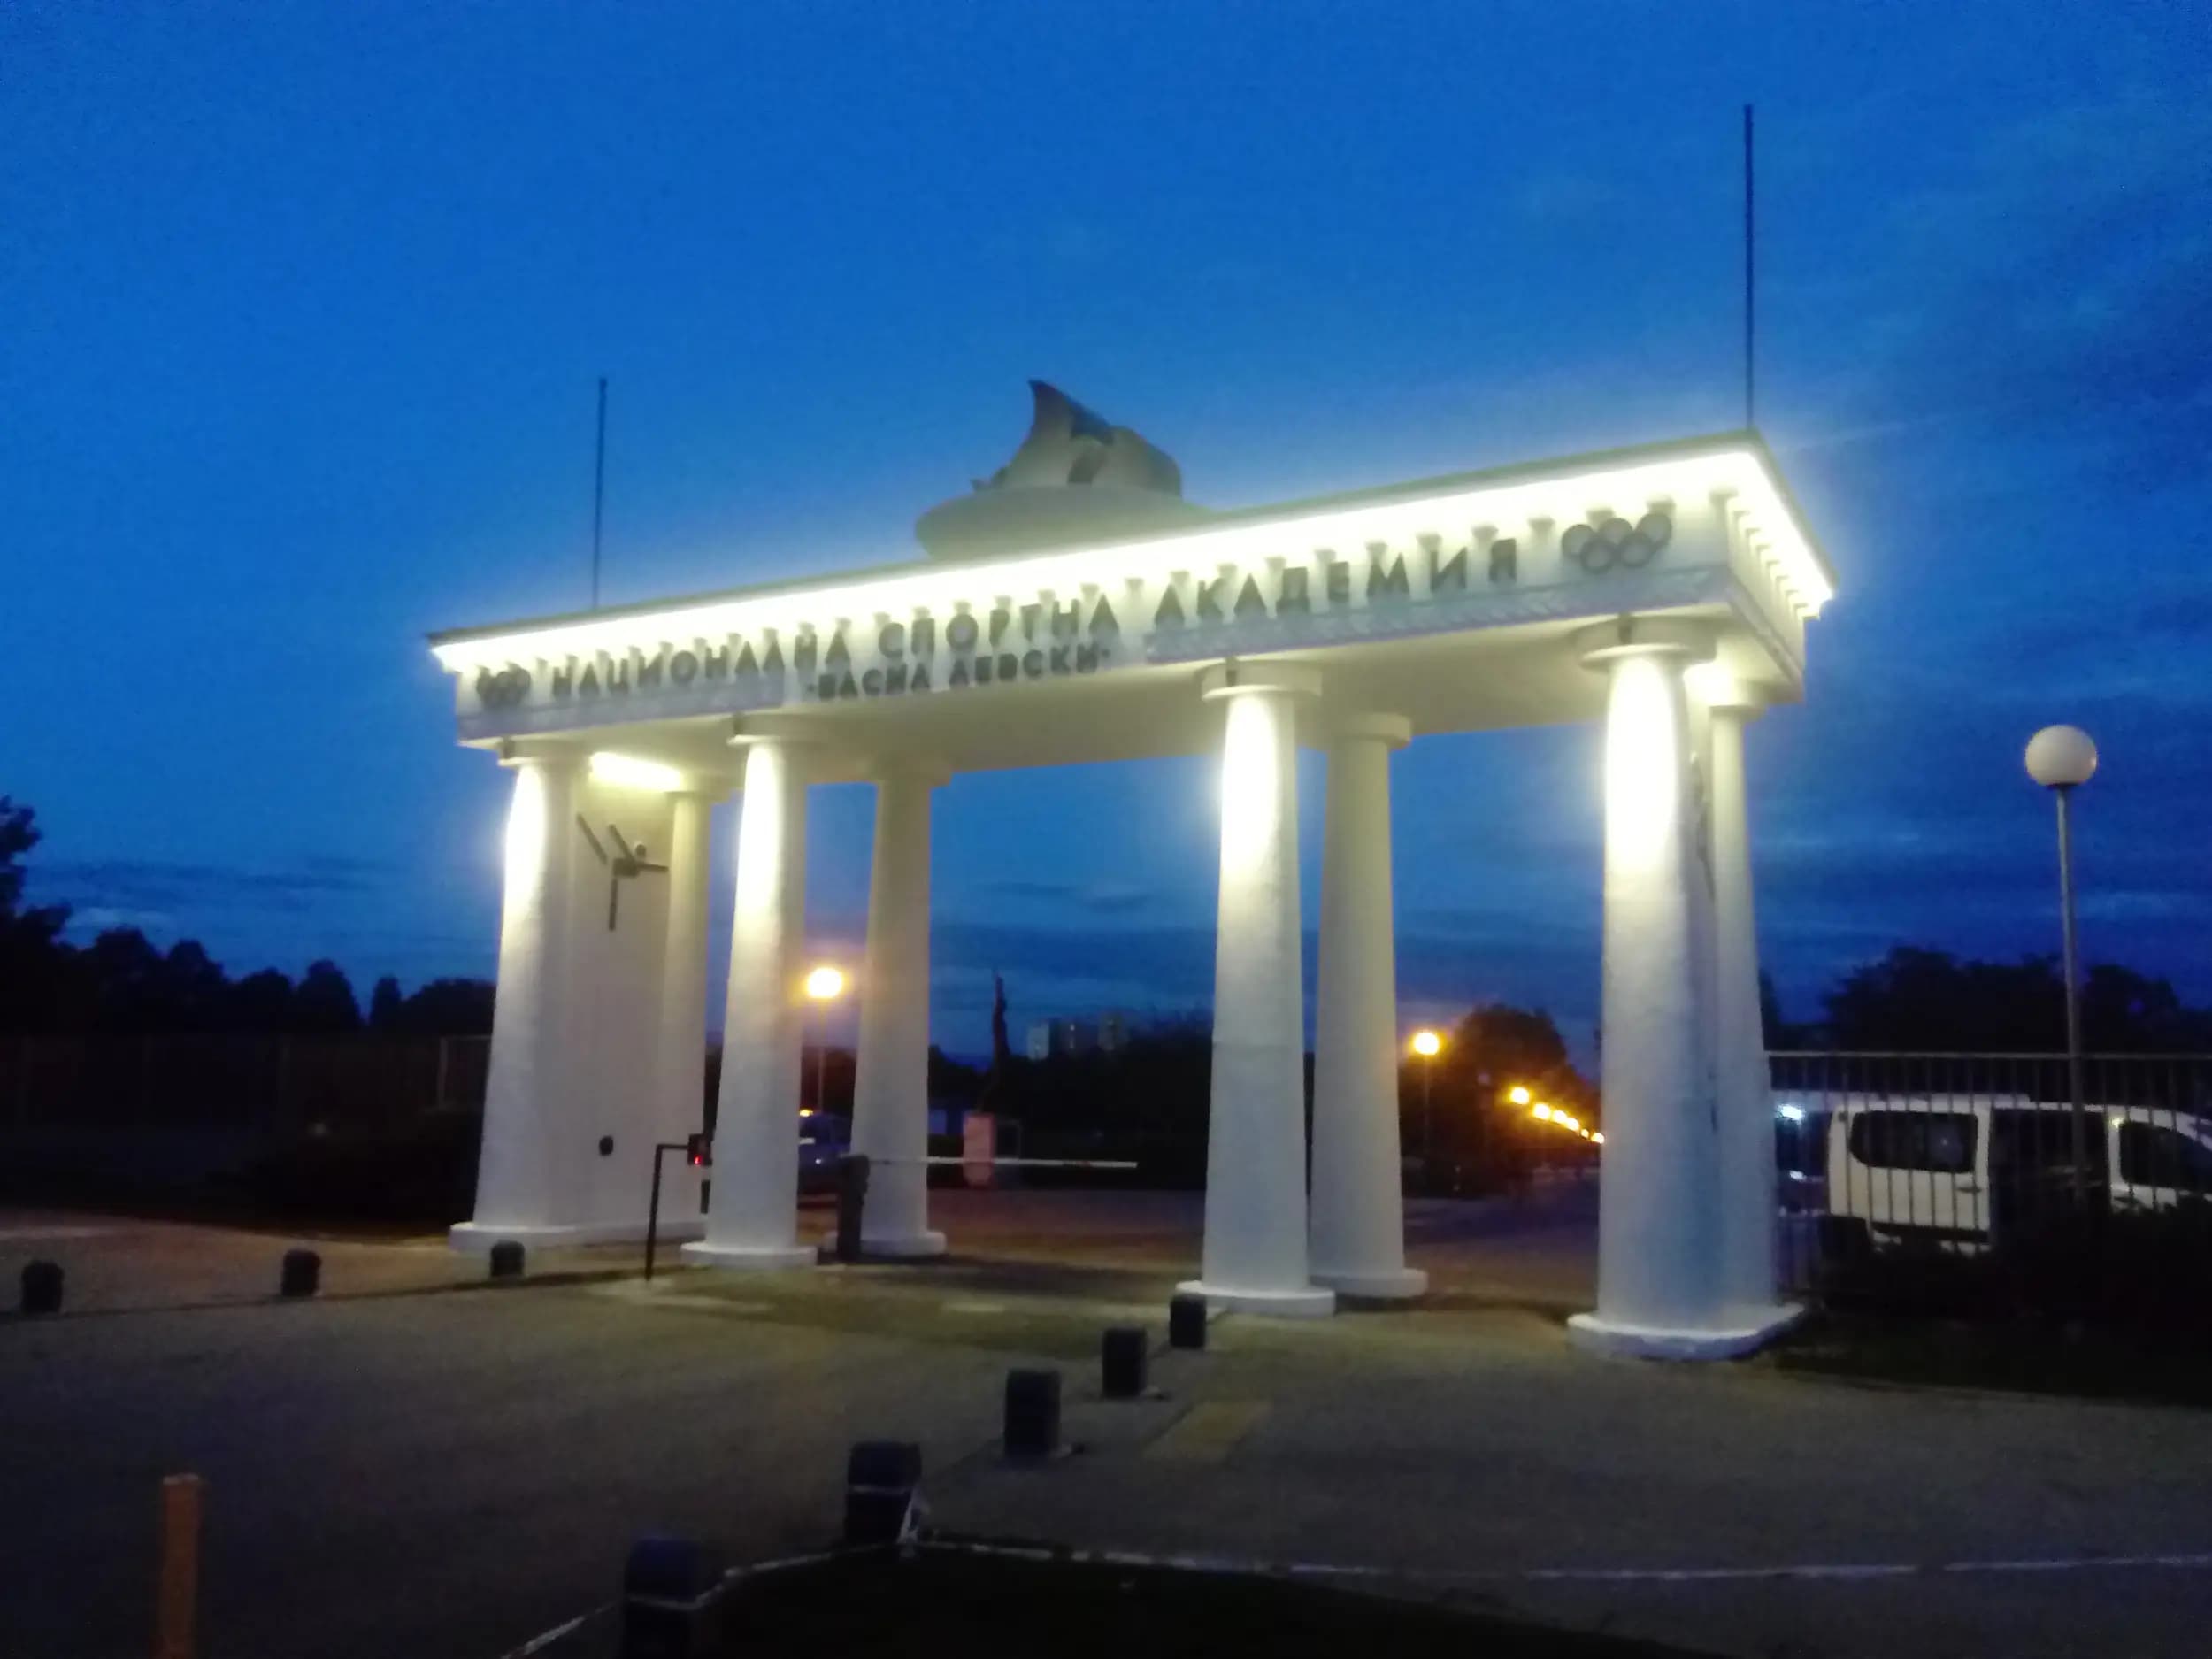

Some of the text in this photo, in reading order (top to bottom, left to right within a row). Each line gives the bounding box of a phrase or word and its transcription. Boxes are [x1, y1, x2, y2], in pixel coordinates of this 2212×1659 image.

[551, 538, 1517, 699] НАЦИОНАЛНА СПОРТНА АКАДЕМИЯ
